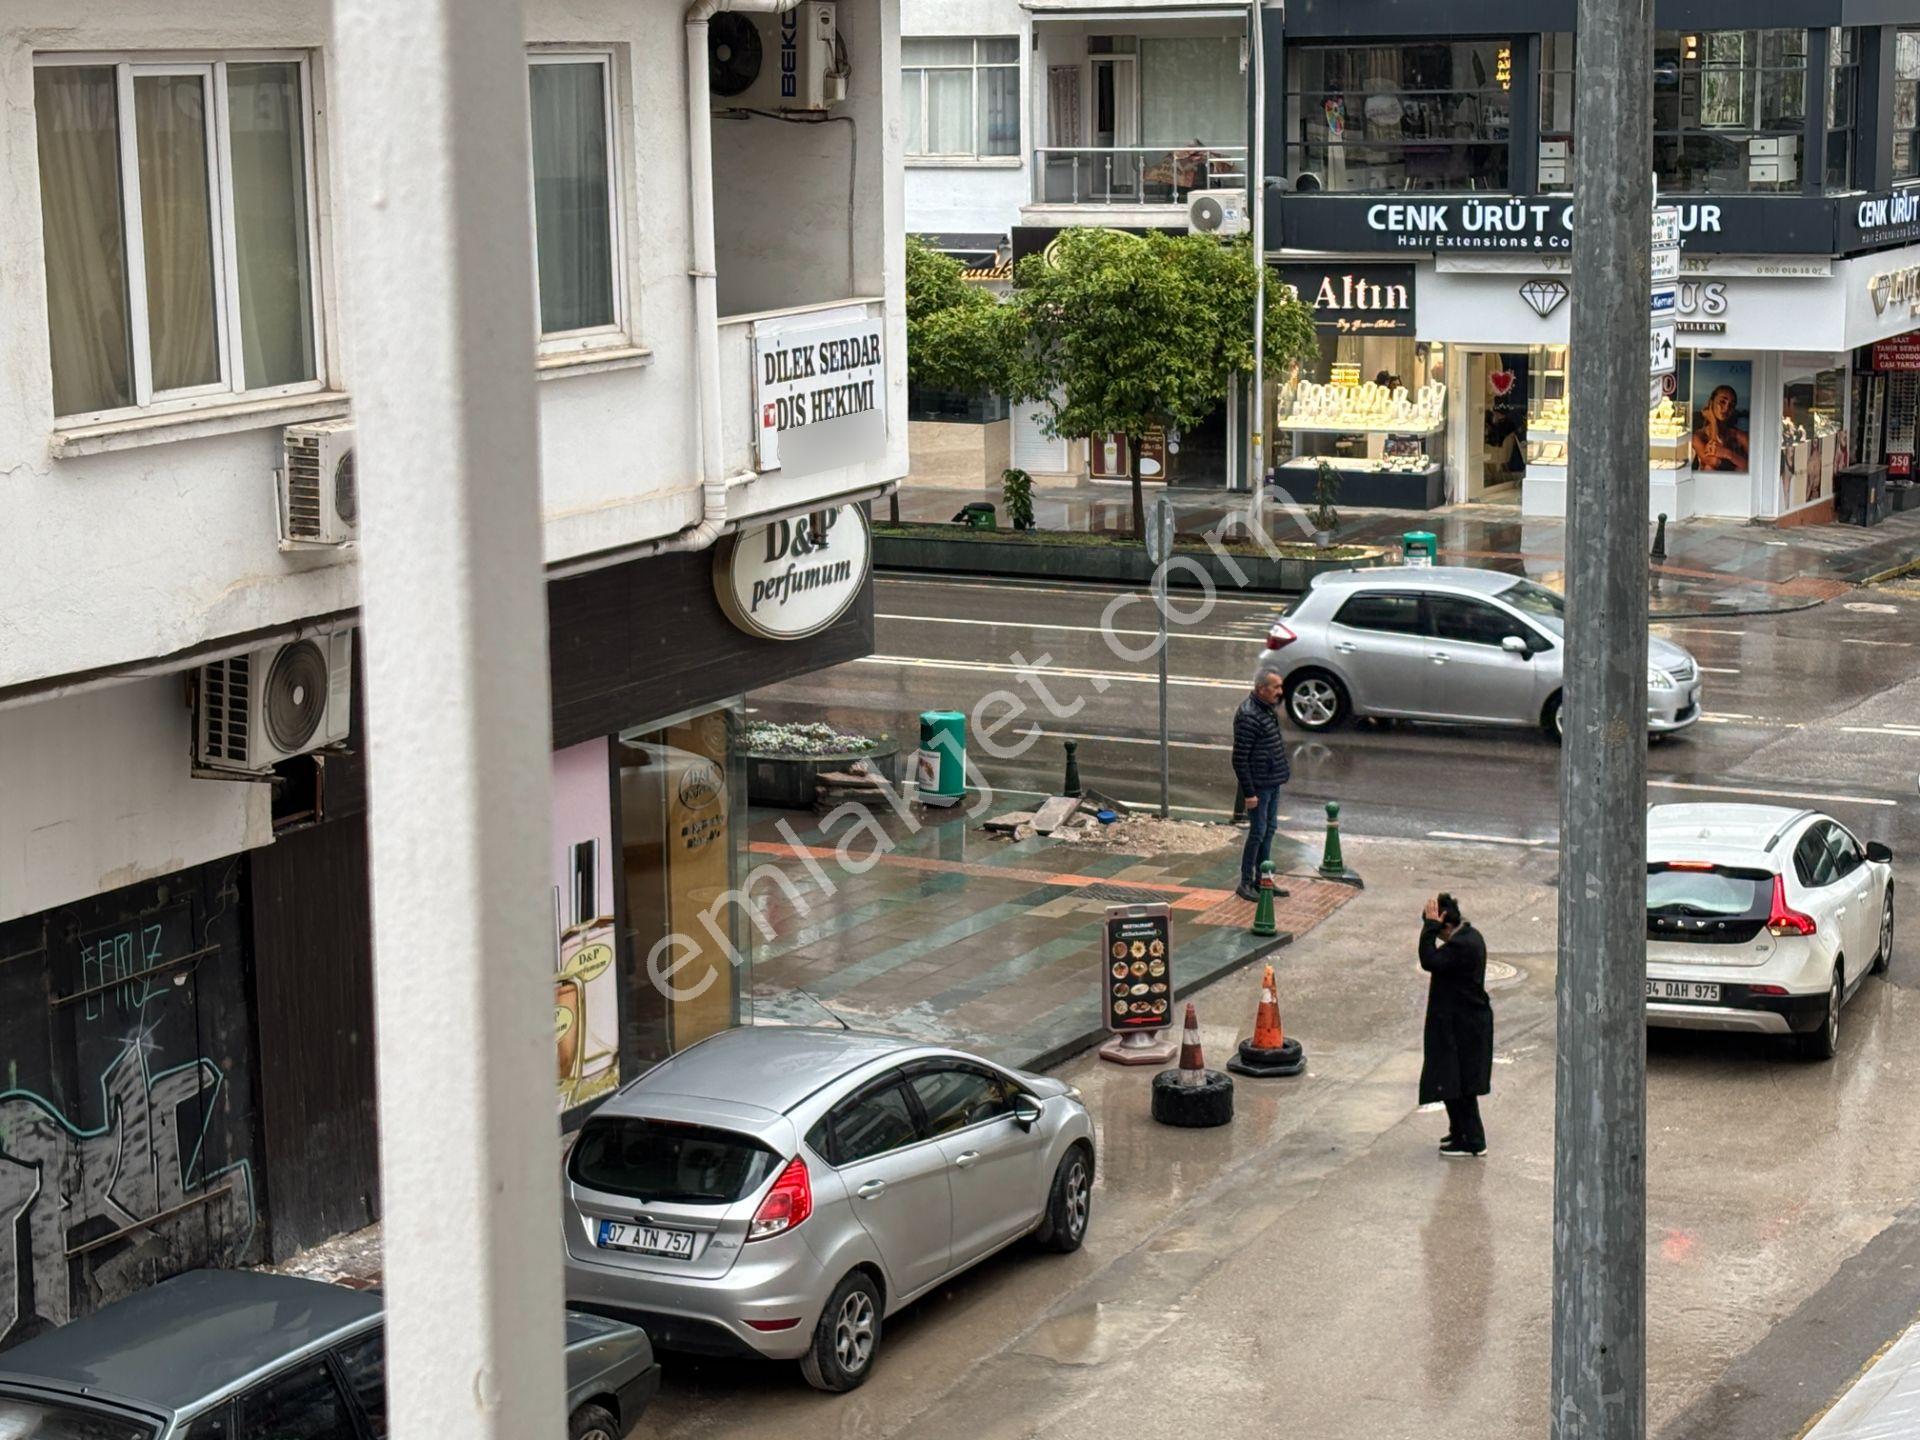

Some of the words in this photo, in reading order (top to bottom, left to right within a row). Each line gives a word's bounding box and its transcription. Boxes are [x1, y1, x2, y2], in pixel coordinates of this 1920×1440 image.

[1367, 204, 1448, 232] CENK
[1462, 199, 1550, 232] ÜRÜT
[1858, 199, 1888, 228] CENK
[1890, 190, 1920, 225] ÜRÜT
[1398, 235, 1430, 247] Hair
[1436, 235, 1528, 248] Extensions
[1534, 236, 1544, 247] &
[1651, 255, 1669, 266] ogar
[1651, 266, 1675, 277] erminal)
[1312, 273, 1410, 310] Altın
[1651, 295, 1675, 309] -Kemer
[764, 339, 816, 386] DİLEK
[819, 333, 882, 375] SERDAR
[810, 368, 875, 424] HEKİMİ
[1890, 456, 1909, 467] 250
[764, 506, 838, 564] D&P
[751, 559, 852, 613] perfumum
[1657, 919, 1726, 930] OLVO
[578, 947, 600, 967] D&P
[1646, 981, 1660, 996] 34
[1665, 983, 1689, 998] DAH
[1694, 984, 1718, 999] 975
[608, 1224, 626, 1243] 07
[632, 1227, 660, 1249] ATN
[664, 1231, 691, 1252] 757
